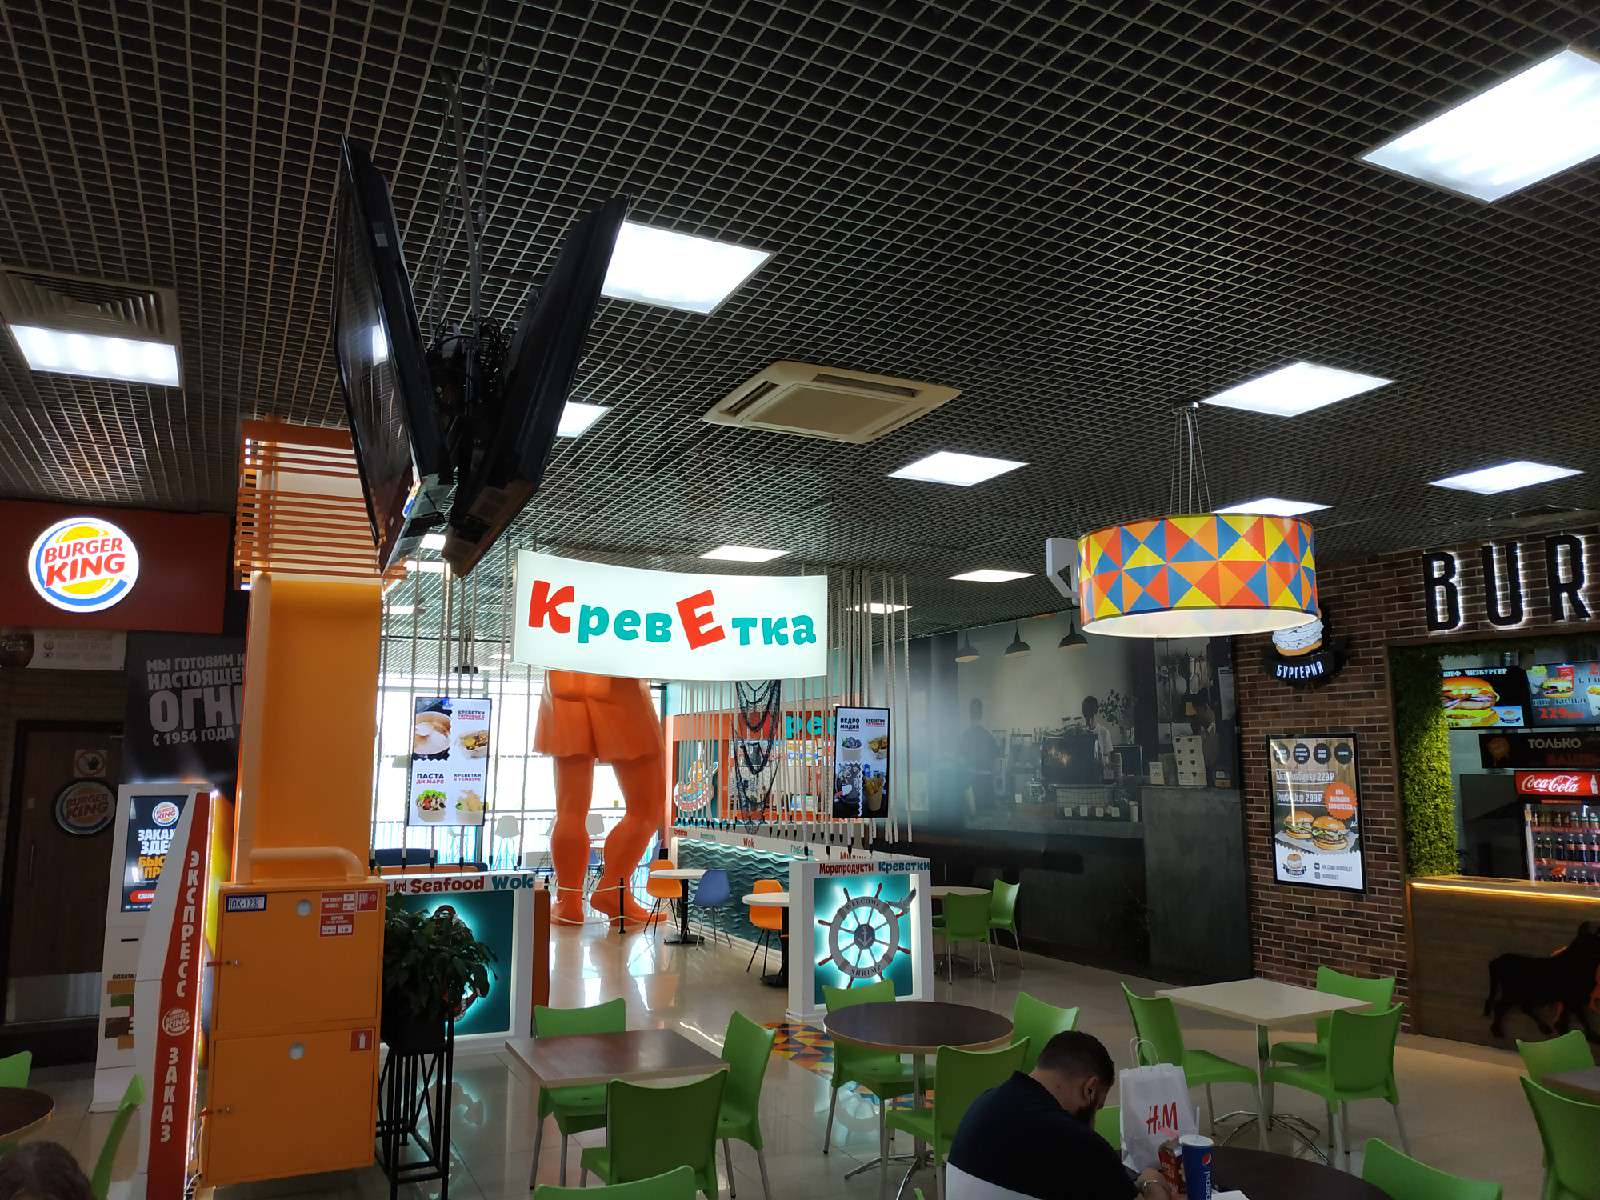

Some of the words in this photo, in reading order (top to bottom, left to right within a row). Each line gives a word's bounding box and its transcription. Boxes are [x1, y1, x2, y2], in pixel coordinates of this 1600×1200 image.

[44, 537, 123, 564] BURGER
[45, 553, 126, 587] KING
[528, 580, 817, 649] КревЕтка
[146, 658, 171, 672] МЫ
[174, 654, 234, 671] ГОТОВИМ
[1276, 661, 1324, 679] БУРГЕРИЯ
[147, 667, 242, 690] НАСТОЯЩЕ
[163, 730, 197, 745] 1954
[201, 726, 235, 742] ГОДА
[1528, 738, 1582, 749] ТОЛЬКО
[140, 841, 171, 855] ЗДЕ
[138, 856, 166, 868] БЫС
[878, 861, 931, 872] Креветки
[410, 875, 485, 894] Seafood
[491, 873, 534, 890] Wok
[177, 850, 200, 999] ЭКСПРЕСС
[160, 1047, 179, 1143] ЗАКАЗ
